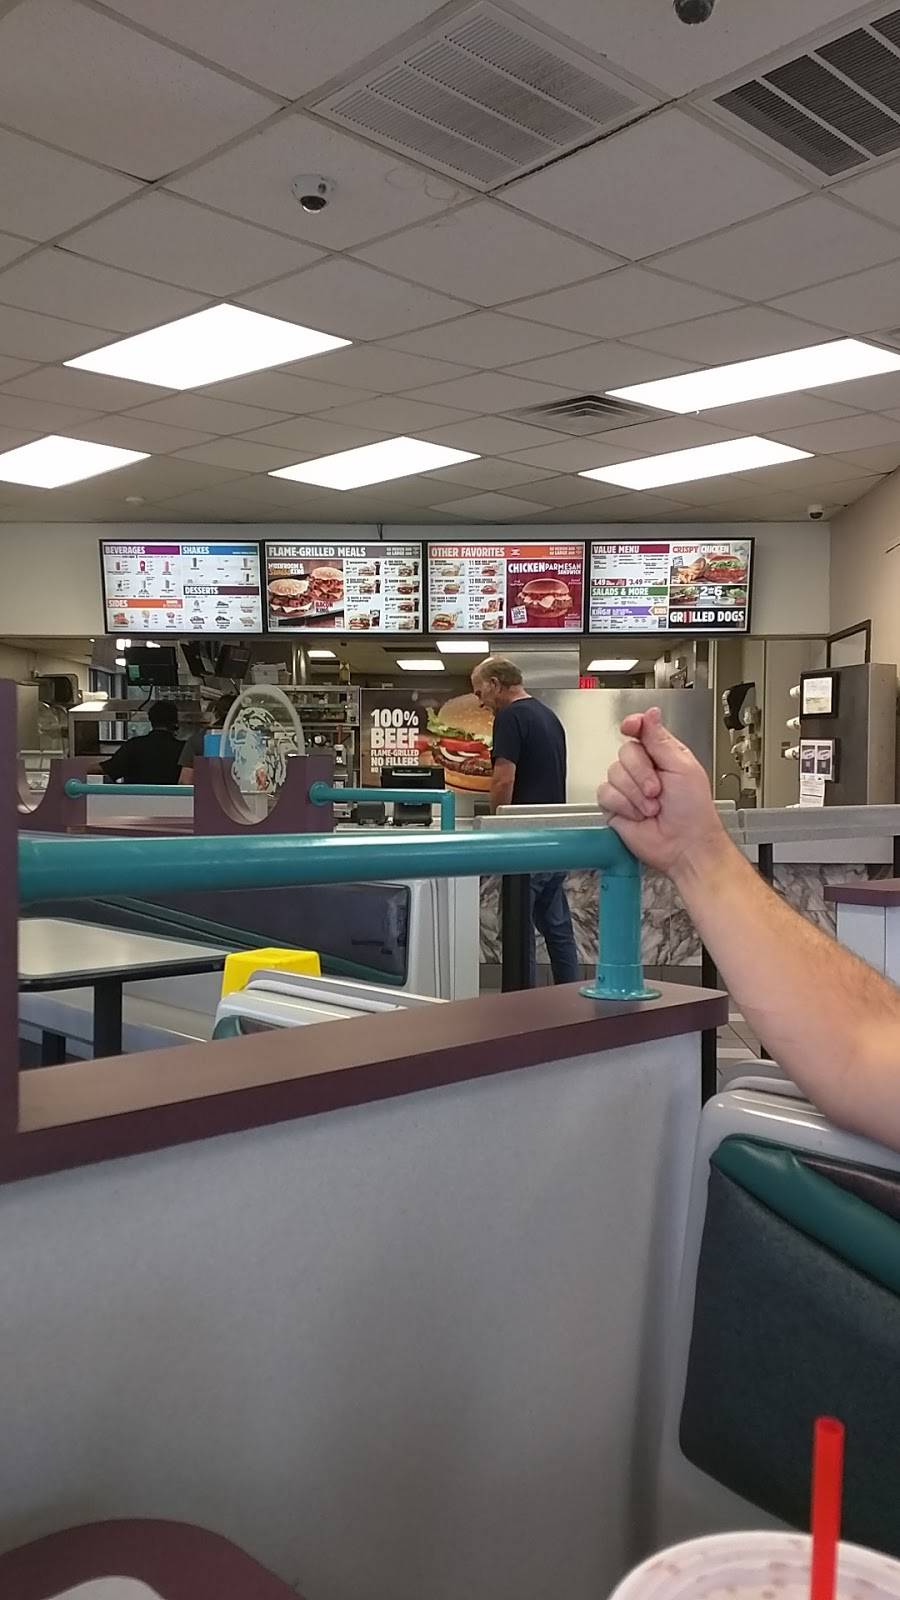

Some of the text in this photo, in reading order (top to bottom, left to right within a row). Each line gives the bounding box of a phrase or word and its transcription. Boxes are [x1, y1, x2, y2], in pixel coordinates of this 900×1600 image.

[104, 546, 146, 554] BEVERAGES
[182, 546, 210, 554] SHAKES
[268, 546, 366, 557] FLAME-GRILLED MEALS
[431, 547, 505, 557] OTHER FAVORITES
[593, 545, 640, 554] VALUE MENU
[672, 545, 699, 553] CRISPY
[508, 562, 545, 574] CHICKEN
[545, 562, 582, 571] PARMESAN
[185, 586, 219, 595] DESSERTS
[592, 587, 649, 596] SALADS & MORE
[700, 586, 709, 596] 2
[109, 599, 129, 608] SIDES
[717, 610, 745, 622] DOGS
[370, 708, 419, 728] 100%
[370, 727, 420, 749] BEEF
[370, 749, 420, 757] FLAME-GRILLED
[370, 756, 420, 767] NO FILLERS
